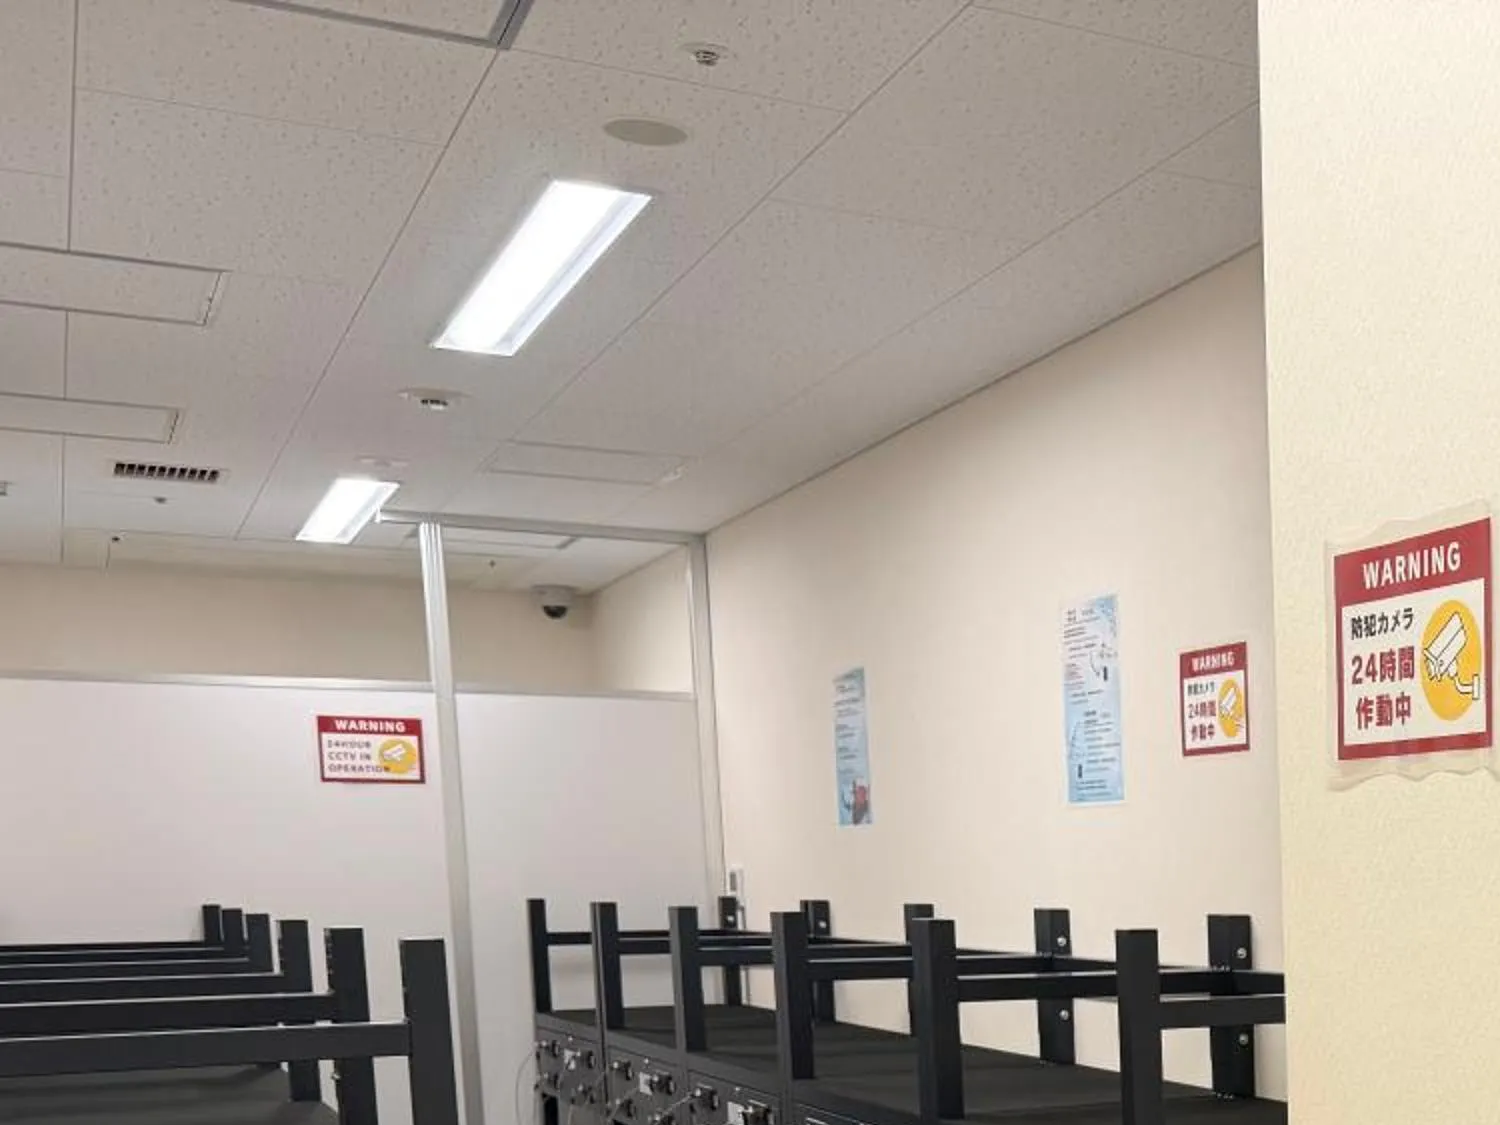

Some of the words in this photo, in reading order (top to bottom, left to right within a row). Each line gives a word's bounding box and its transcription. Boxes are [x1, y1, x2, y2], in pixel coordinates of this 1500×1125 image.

[1362, 541, 1461, 590] WARNING
[1350, 607, 1415, 640] 防犯カメラ
[1351, 646, 1416, 685] 24時間
[334, 719, 406, 733] WARNING
[1355, 692, 1412, 730] 作動中
[328, 752, 356, 761] CCTV
